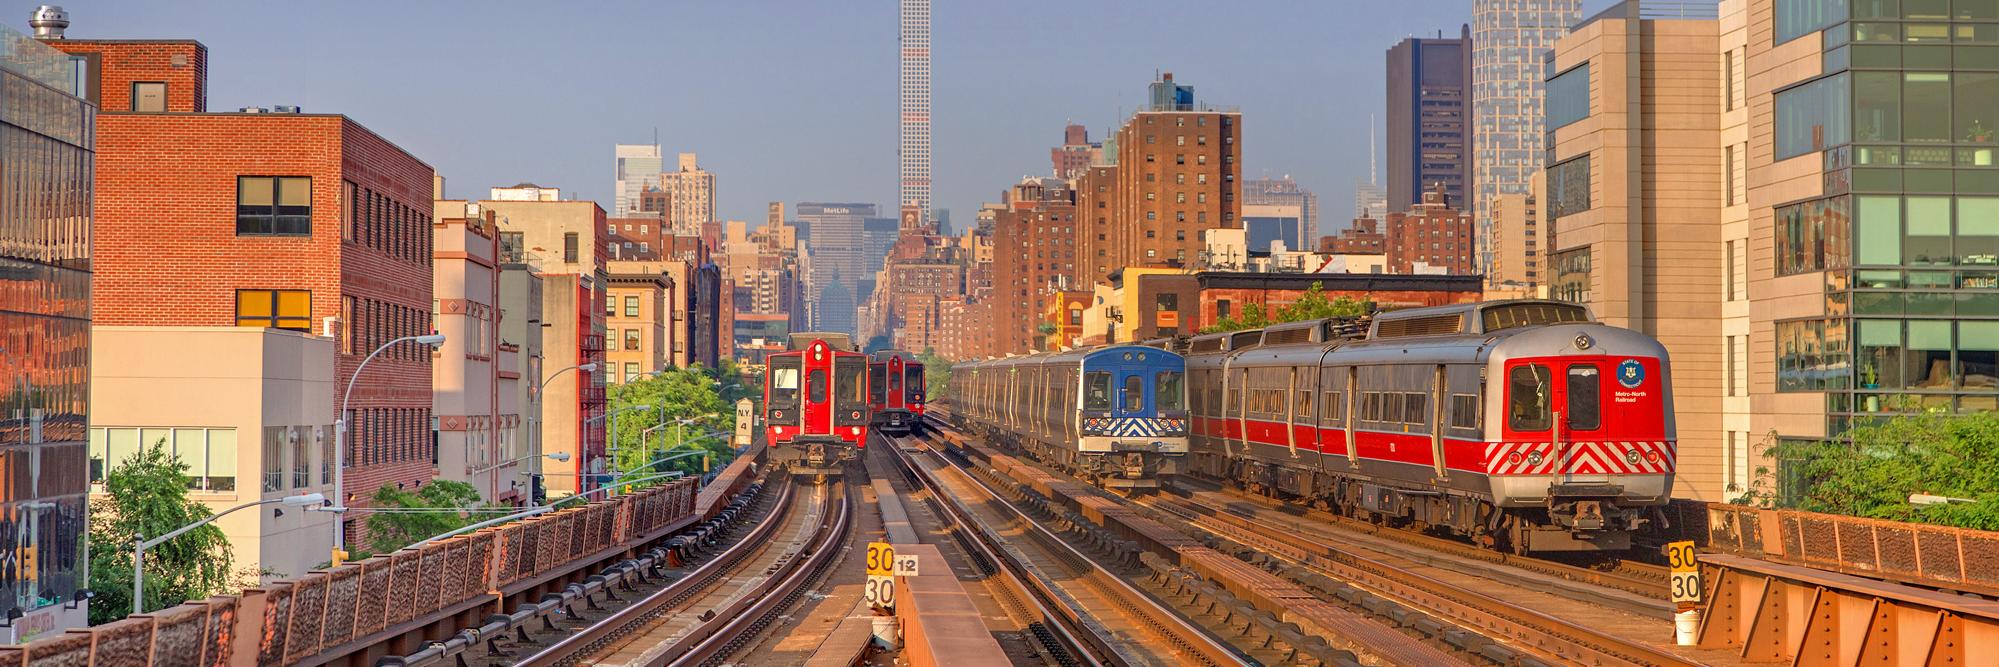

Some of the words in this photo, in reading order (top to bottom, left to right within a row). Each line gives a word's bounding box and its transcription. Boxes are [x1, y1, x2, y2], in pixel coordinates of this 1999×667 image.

[740, 422, 747, 430] 4
[867, 547, 894, 571] 30
[898, 560, 916, 571] 12
[1670, 545, 1696, 568] 30
[865, 579, 894, 604] 30
[1672, 575, 1699, 598] 30
